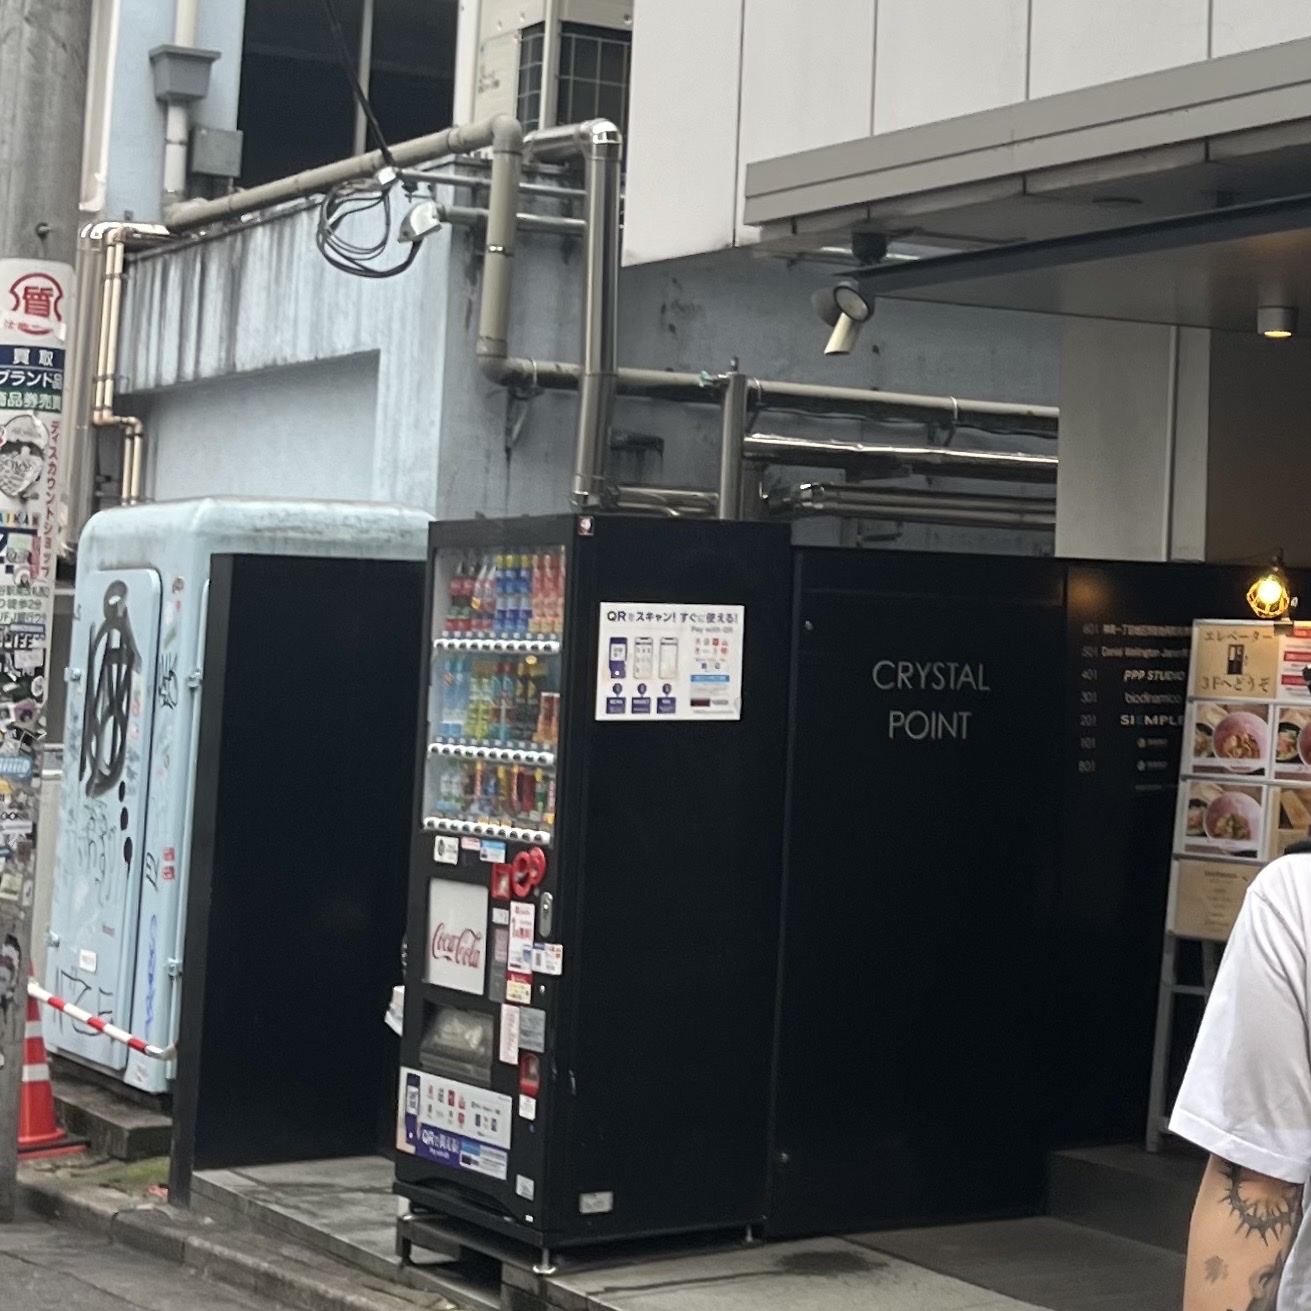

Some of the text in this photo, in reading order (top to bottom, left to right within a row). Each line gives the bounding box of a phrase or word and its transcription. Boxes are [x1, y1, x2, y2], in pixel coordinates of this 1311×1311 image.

[23, 286, 54, 318] 質
[13, 347, 54, 367] 買取
[872, 660, 991, 691] CRYSTAL
[888, 710, 972, 740] POINT
